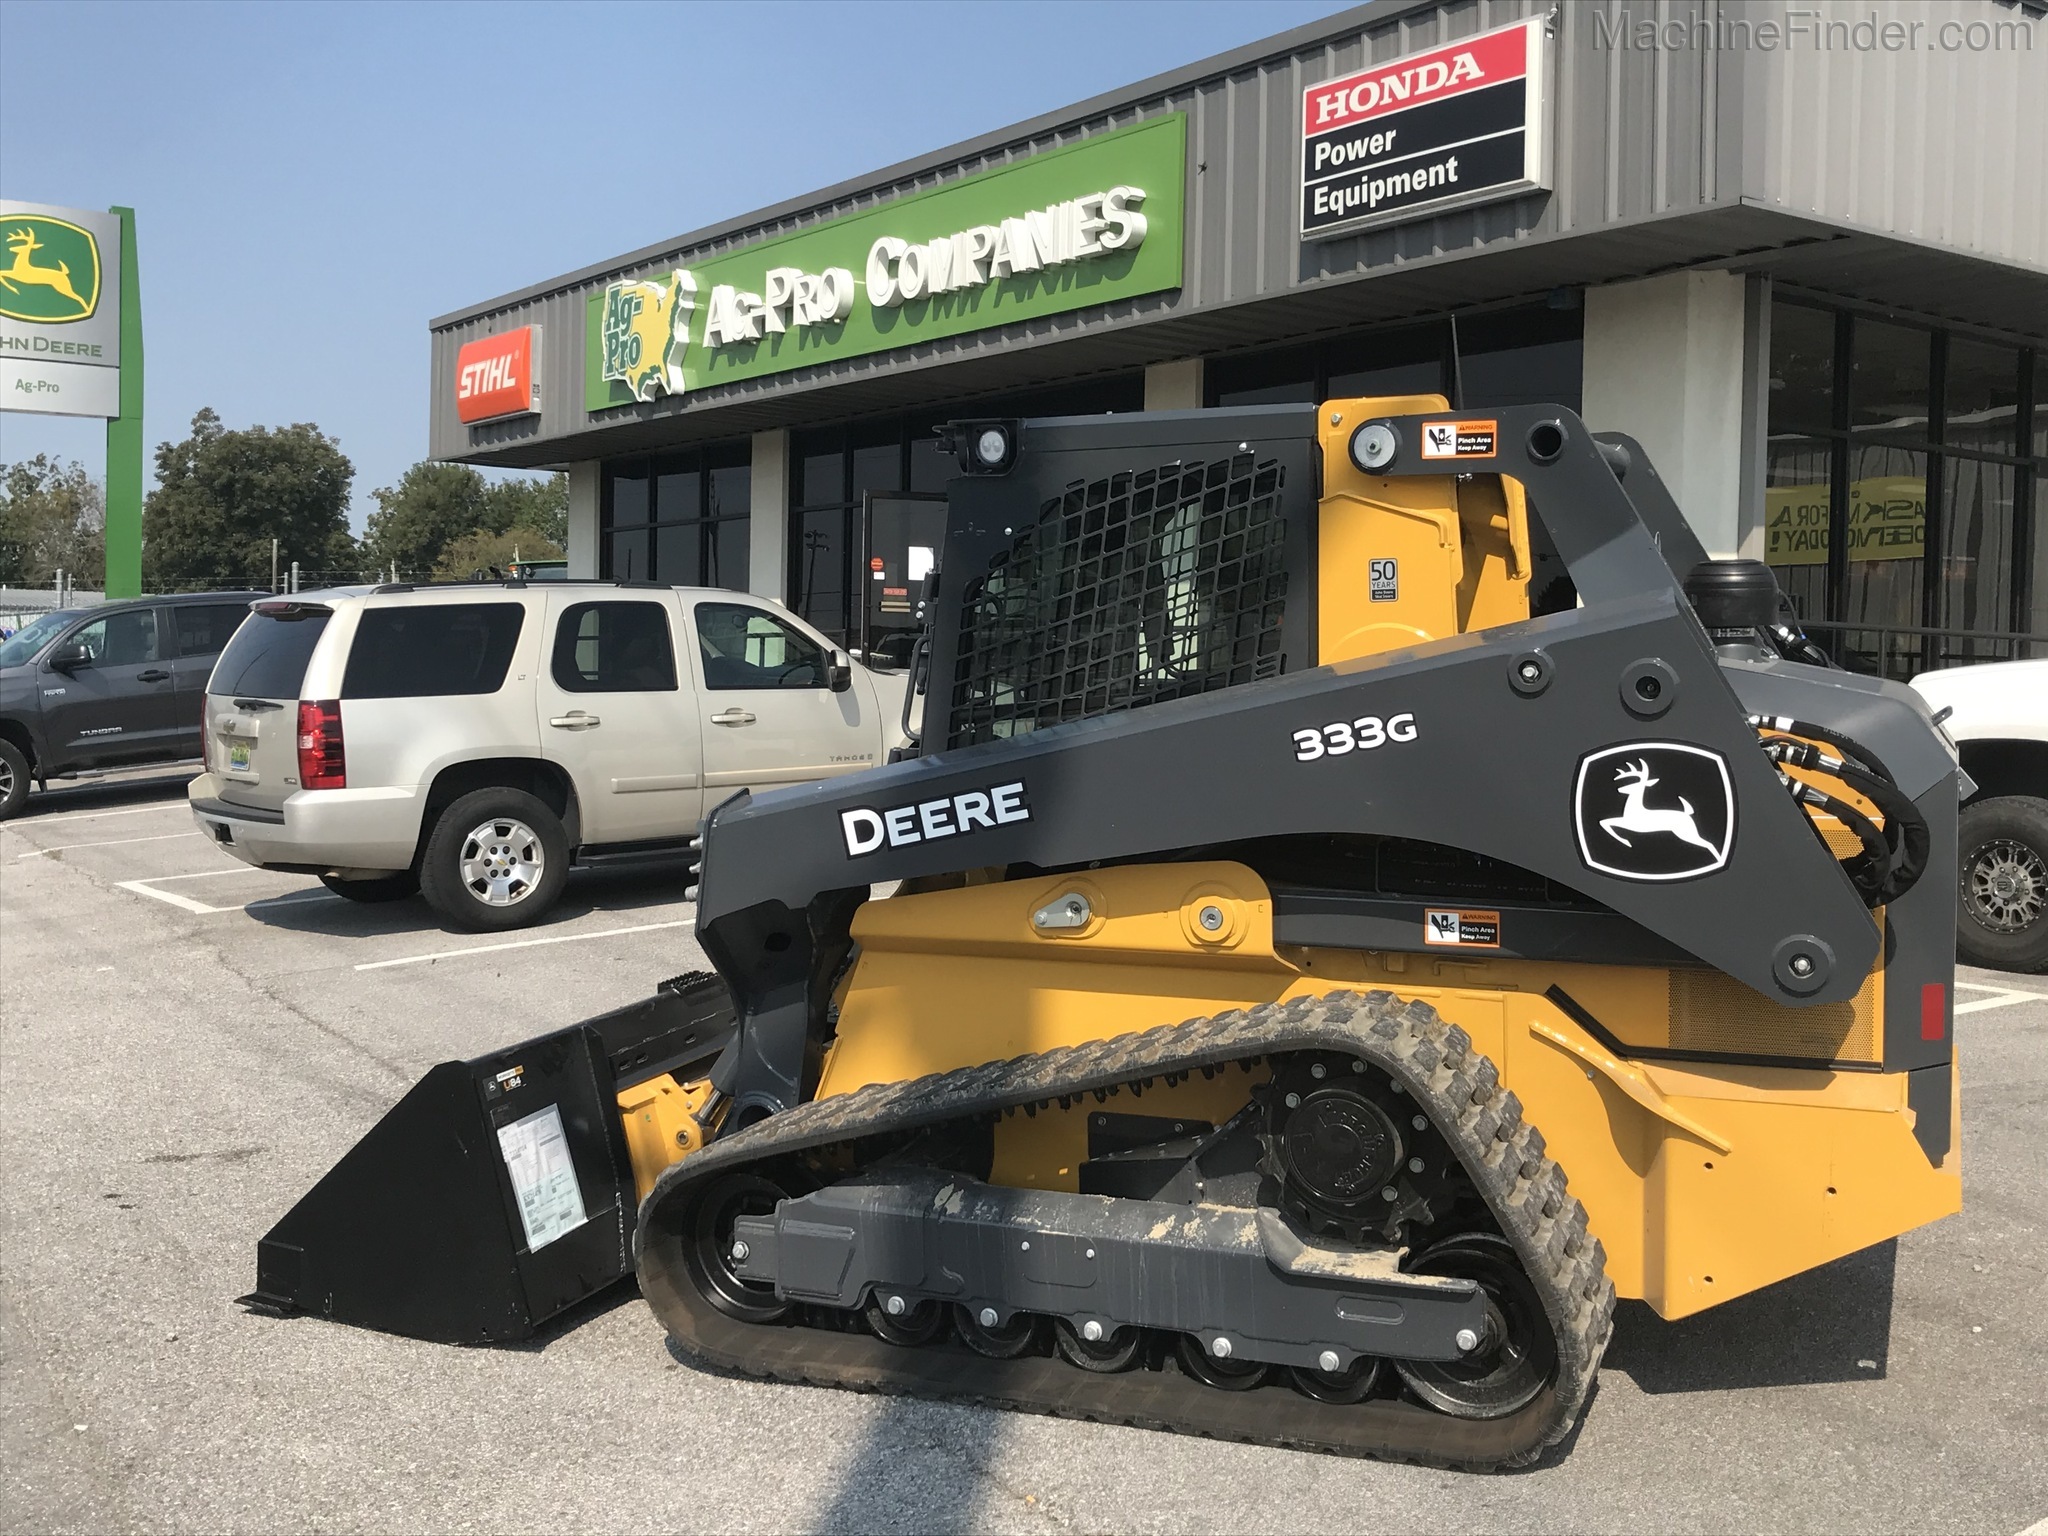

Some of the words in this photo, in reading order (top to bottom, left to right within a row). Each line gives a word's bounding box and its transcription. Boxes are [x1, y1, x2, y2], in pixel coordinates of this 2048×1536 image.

[1316, 52, 1485, 124] HONDA
[1314, 129, 1396, 171] Power
[1314, 155, 1459, 216] Equipment
[866, 185, 1147, 308] COMPANIES
[605, 284, 644, 338] Ag-
[33, 336, 102, 357] DEERE
[604, 333, 643, 378] Pro
[15, 378, 60, 394] Ag-Pro
[459, 353, 516, 399] STIHL
[1371, 560, 1396, 581] 50
[80, 726, 122, 736] TUNDRA
[1293, 713, 1418, 761] 333G
[829, 754, 865, 762] TAHOE
[842, 782, 1030, 856] DEERE
[1468, 913, 1496, 921] WARNING
